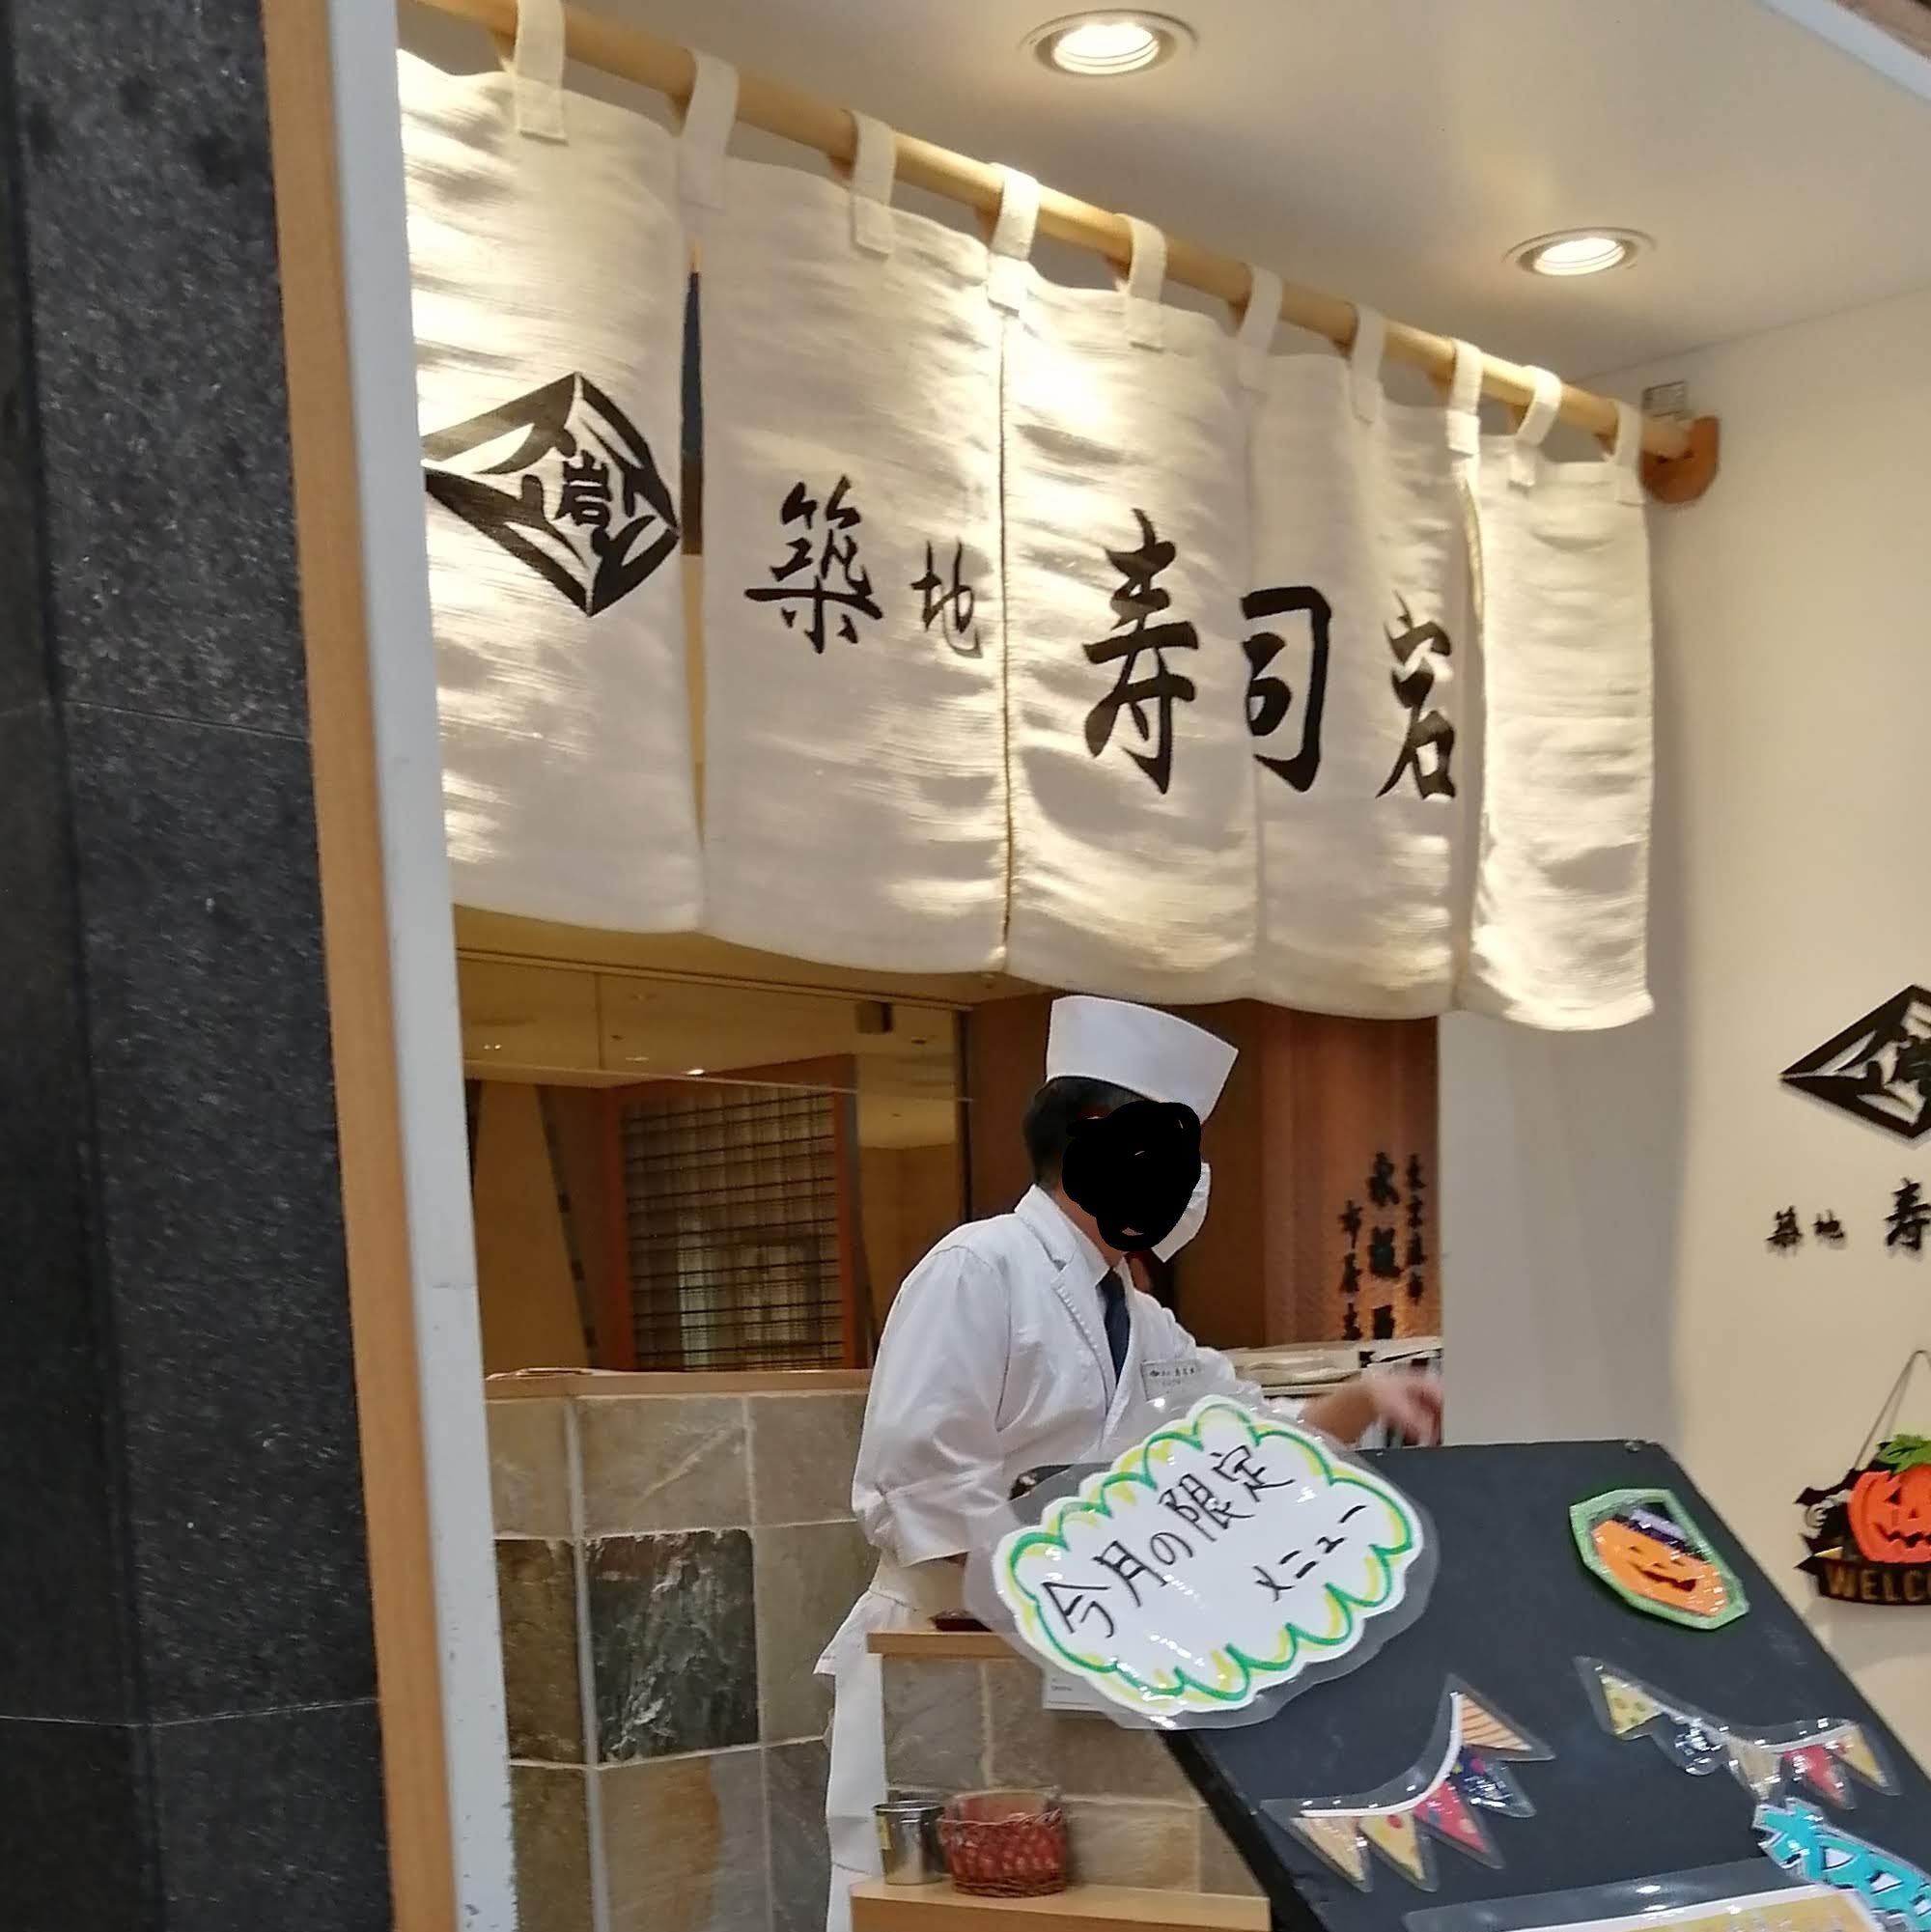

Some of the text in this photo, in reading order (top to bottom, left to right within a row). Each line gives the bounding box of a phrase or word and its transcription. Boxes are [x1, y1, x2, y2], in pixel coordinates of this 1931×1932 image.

[745, 475, 983, 654] 築地
[1042, 1444, 1296, 1638] 今月の限定
[1253, 1504, 1366, 1603] メニュー
[1824, 1564, 1931, 1602] WELC
